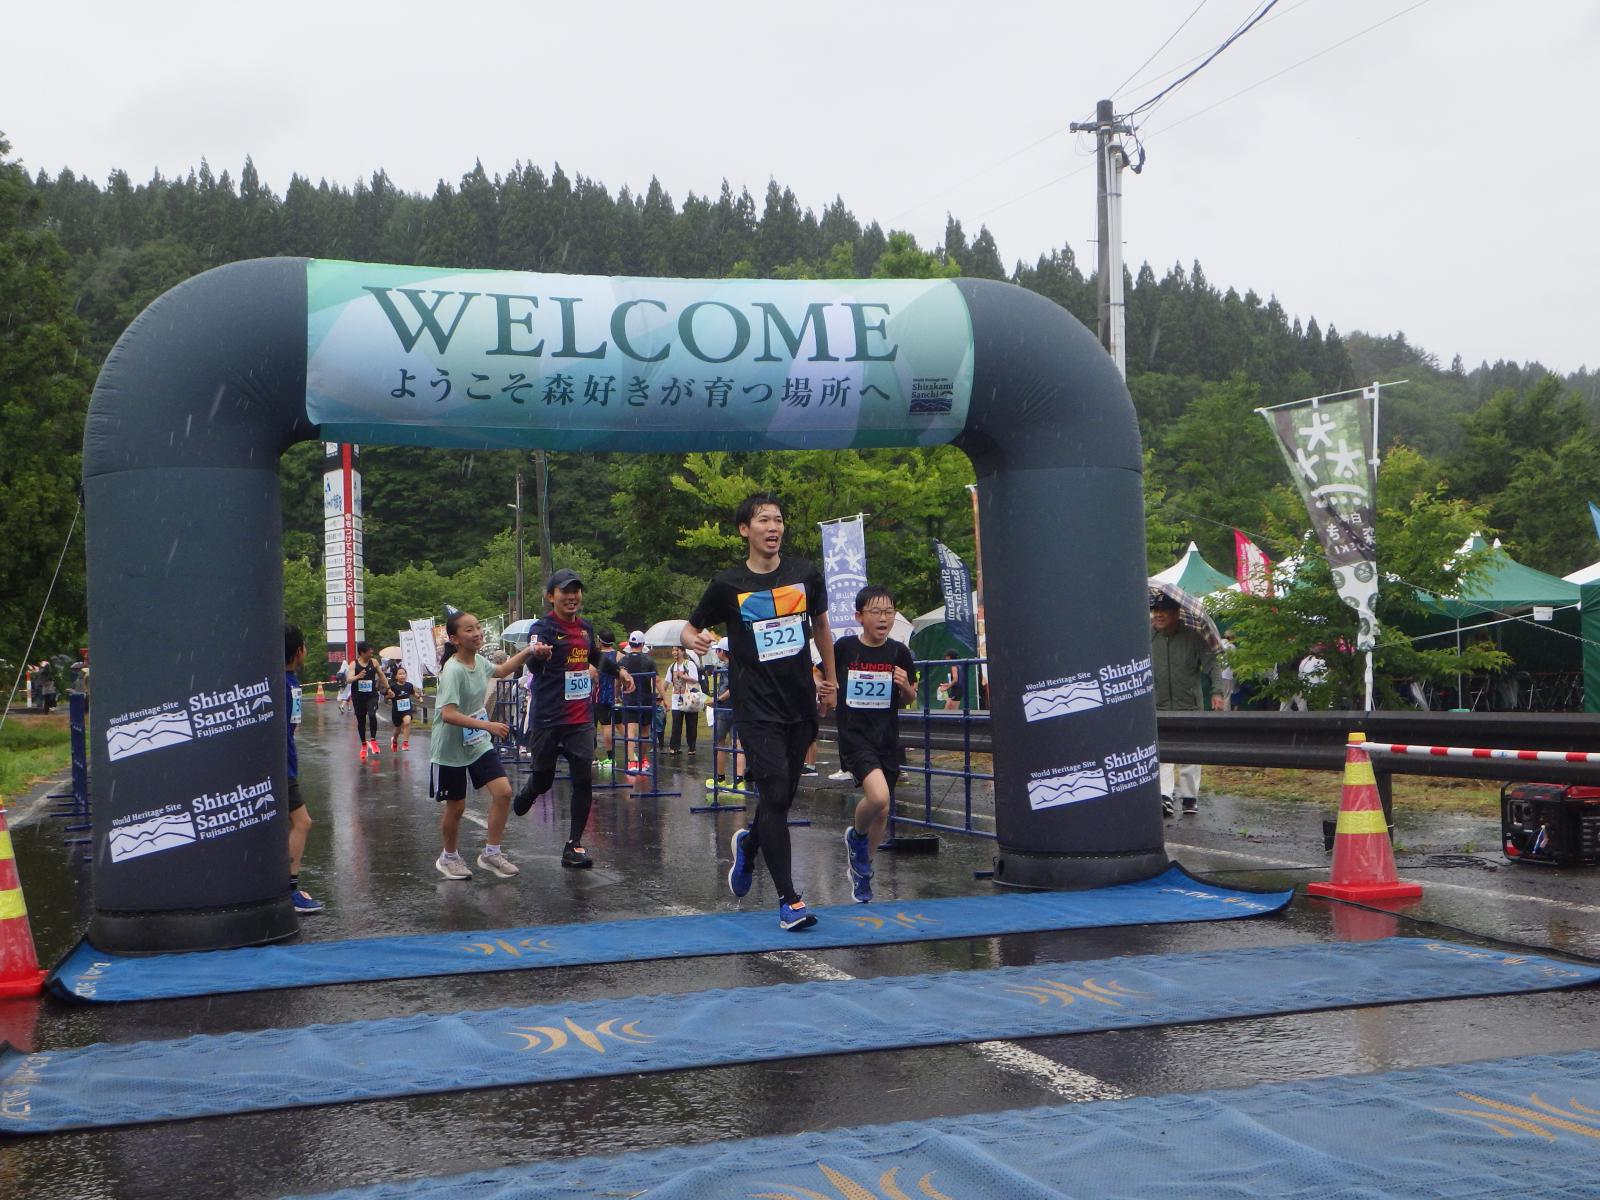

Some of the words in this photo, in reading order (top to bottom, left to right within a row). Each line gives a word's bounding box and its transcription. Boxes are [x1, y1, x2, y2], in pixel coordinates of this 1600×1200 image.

[362, 286, 898, 363] WELCOME
[390, 367, 891, 408] ようこそ森好きが育つ場所へ
[911, 390, 939, 399] Sanchi
[912, 382, 953, 391] Shirakami
[763, 627, 797, 647] 522
[1099, 653, 1152, 681] Shirakami
[570, 678, 589, 691] 508
[853, 681, 886, 697] 522
[1025, 681, 1046, 691] World
[1046, 675, 1077, 687] Heritage
[1077, 672, 1091, 680] Site
[1102, 674, 1143, 696] Sanchi
[189, 677, 270, 712] Shirakami
[109, 714, 129, 726] World
[129, 705, 162, 719] Heritage
[162, 701, 179, 711] Site
[193, 701, 251, 728] Sanchi
[258, 710, 274, 722] Japan
[1104, 740, 1157, 770] Shirakami
[1030, 770, 1051, 779] World
[1052, 763, 1081, 775] Heritage
[1082, 760, 1096, 768] Site
[1108, 761, 1149, 785] Sanchi
[192, 776, 273, 814] Shirakami
[112, 815, 131, 826] World
[132, 807, 164, 821] Heritage
[165, 803, 182, 813] Site
[196, 801, 254, 830] Sanchi
[261, 809, 277, 822] Japan
